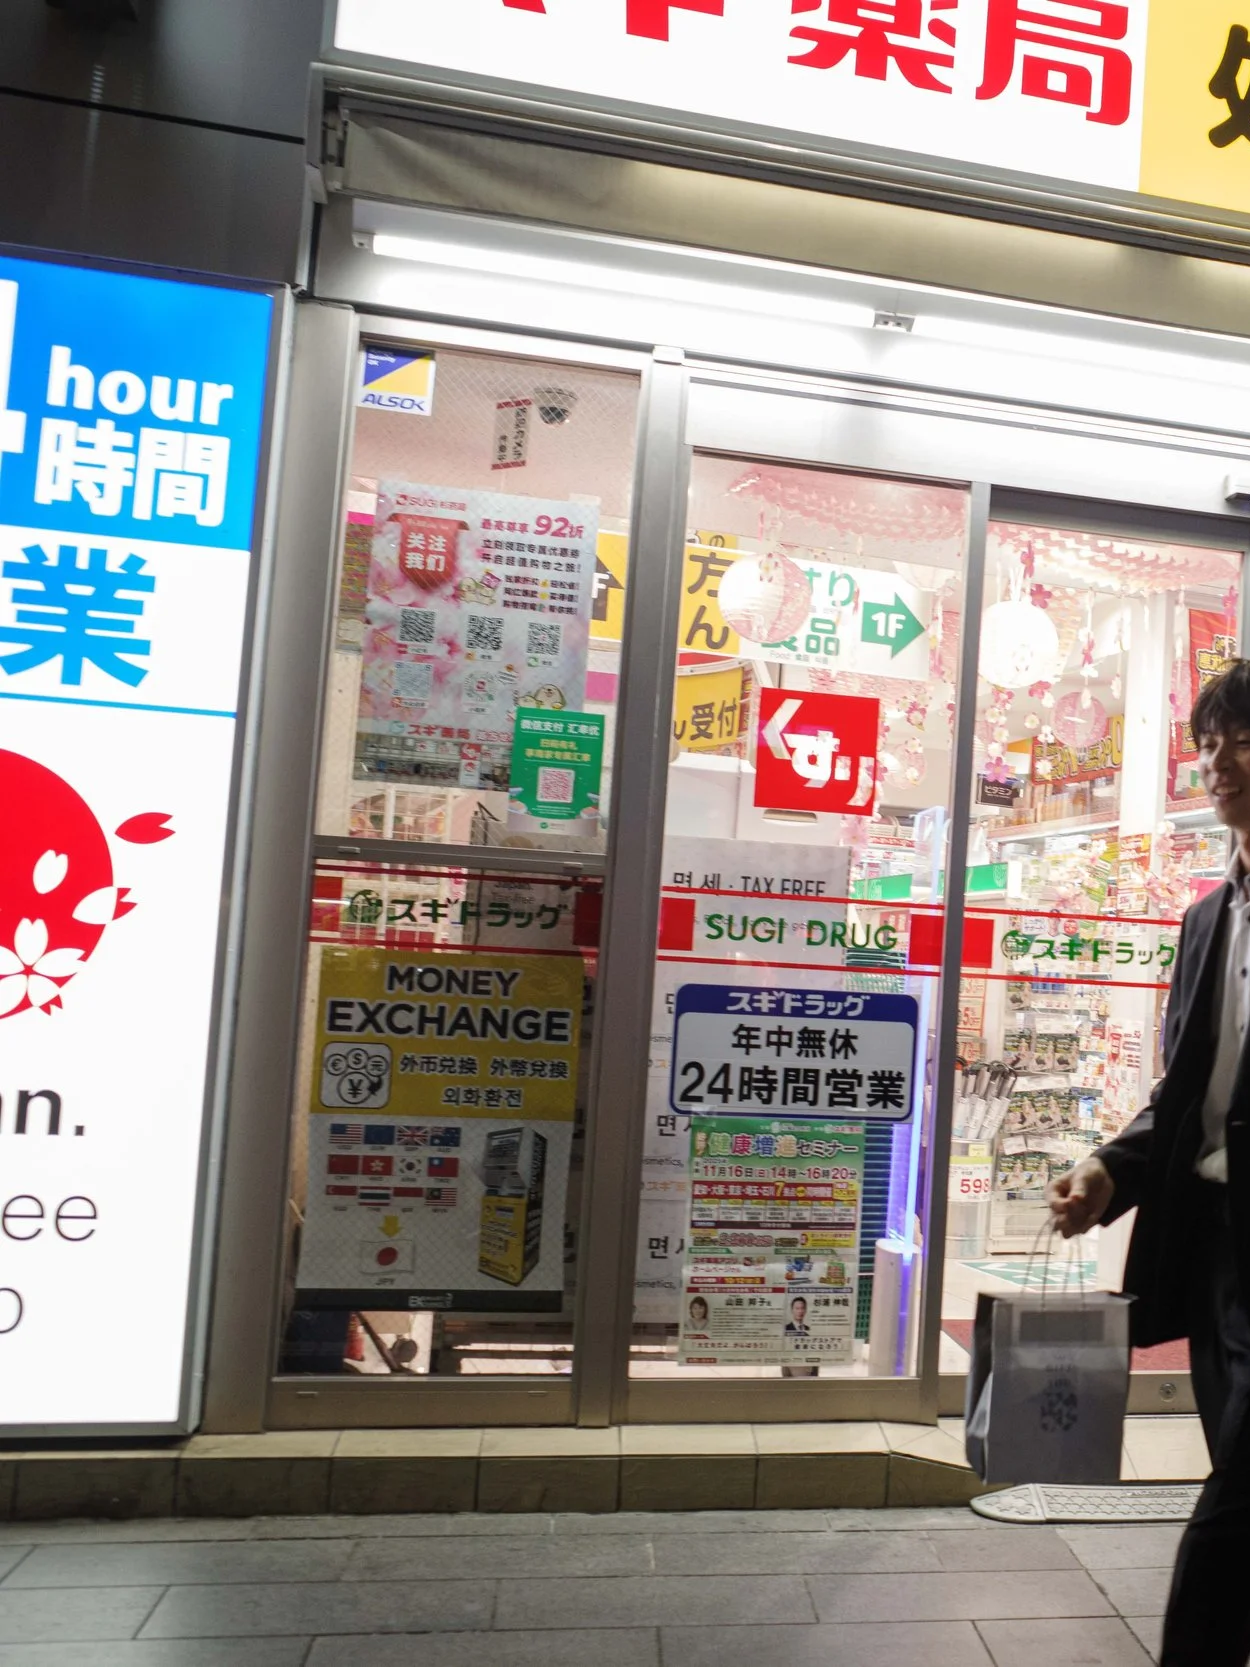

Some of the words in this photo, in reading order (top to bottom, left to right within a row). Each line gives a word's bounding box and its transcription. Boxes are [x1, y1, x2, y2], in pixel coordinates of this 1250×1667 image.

[46, 345, 234, 426] hour
[361, 393, 426, 412] ALSOK
[34, 418, 231, 528] 時間
[406, 531, 447, 553] 关注
[533, 514, 584, 539] 92折
[405, 551, 446, 572] 我们
[0, 543, 156, 689] 業
[685, 606, 729, 650] ん
[871, 612, 906, 638] 1F
[762, 699, 875, 806] くすり
[740, 876, 775, 895] TAX
[780, 878, 826, 898] FREE
[386, 897, 570, 929] スギドラッグ
[705, 913, 787, 945] SUGI
[805, 919, 898, 951] DRUG
[1032, 938, 1177, 967] スギドラッグ
[386, 963, 520, 998] MONEY
[726, 991, 872, 1017] スギドラッグ
[326, 1000, 573, 1043] EXCHANGE
[731, 1023, 859, 1060] 年中無休
[399, 1053, 479, 1075] 外币兑换
[442, 1087, 524, 1109] 외화환전
[680, 1061, 906, 1110] 24時間営業
[0, 1086, 87, 1137] n.
[708, 1132, 859, 1158] 健康増進セミナー
